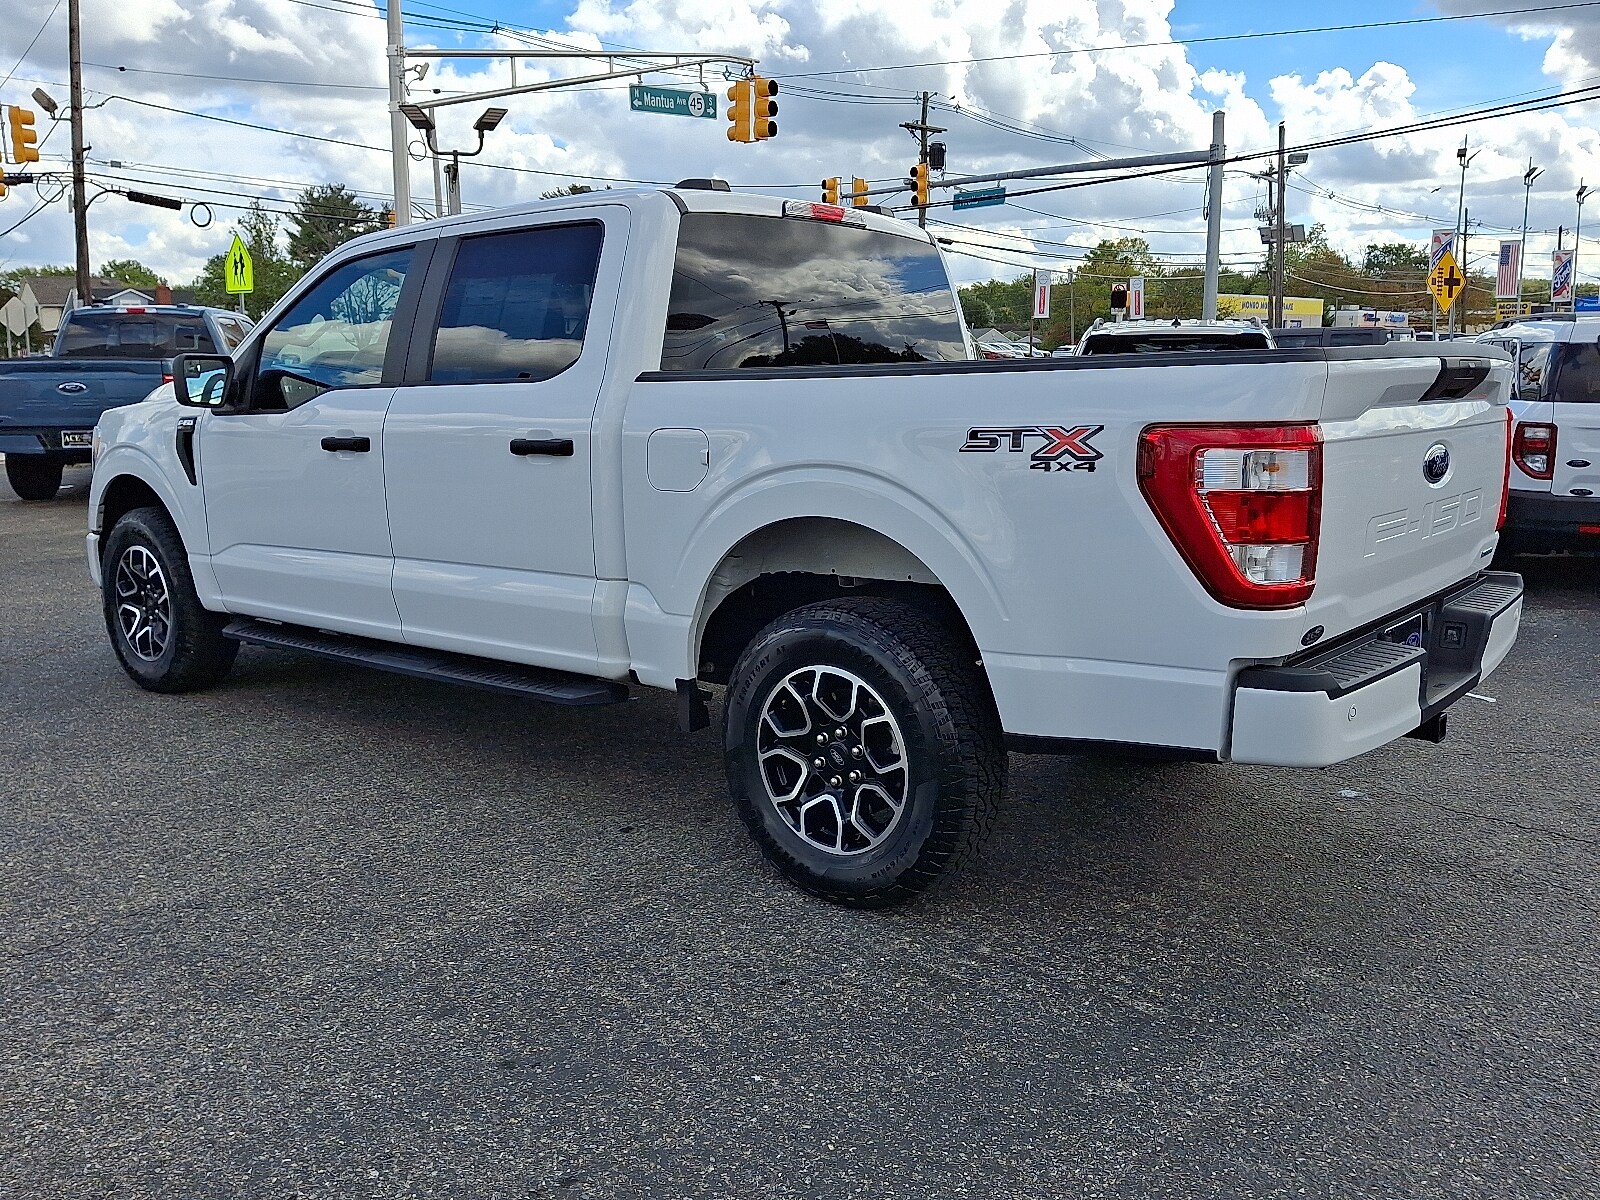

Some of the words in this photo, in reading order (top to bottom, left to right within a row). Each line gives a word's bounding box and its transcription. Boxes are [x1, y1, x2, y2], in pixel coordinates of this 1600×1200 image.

[634, 88, 640, 98] N
[643, 92, 675, 109] Mantua
[676, 95, 687, 106] Ave
[690, 97, 703, 111] 45
[958, 425, 1105, 462] STX
[1363, 487, 1484, 558] F-150
